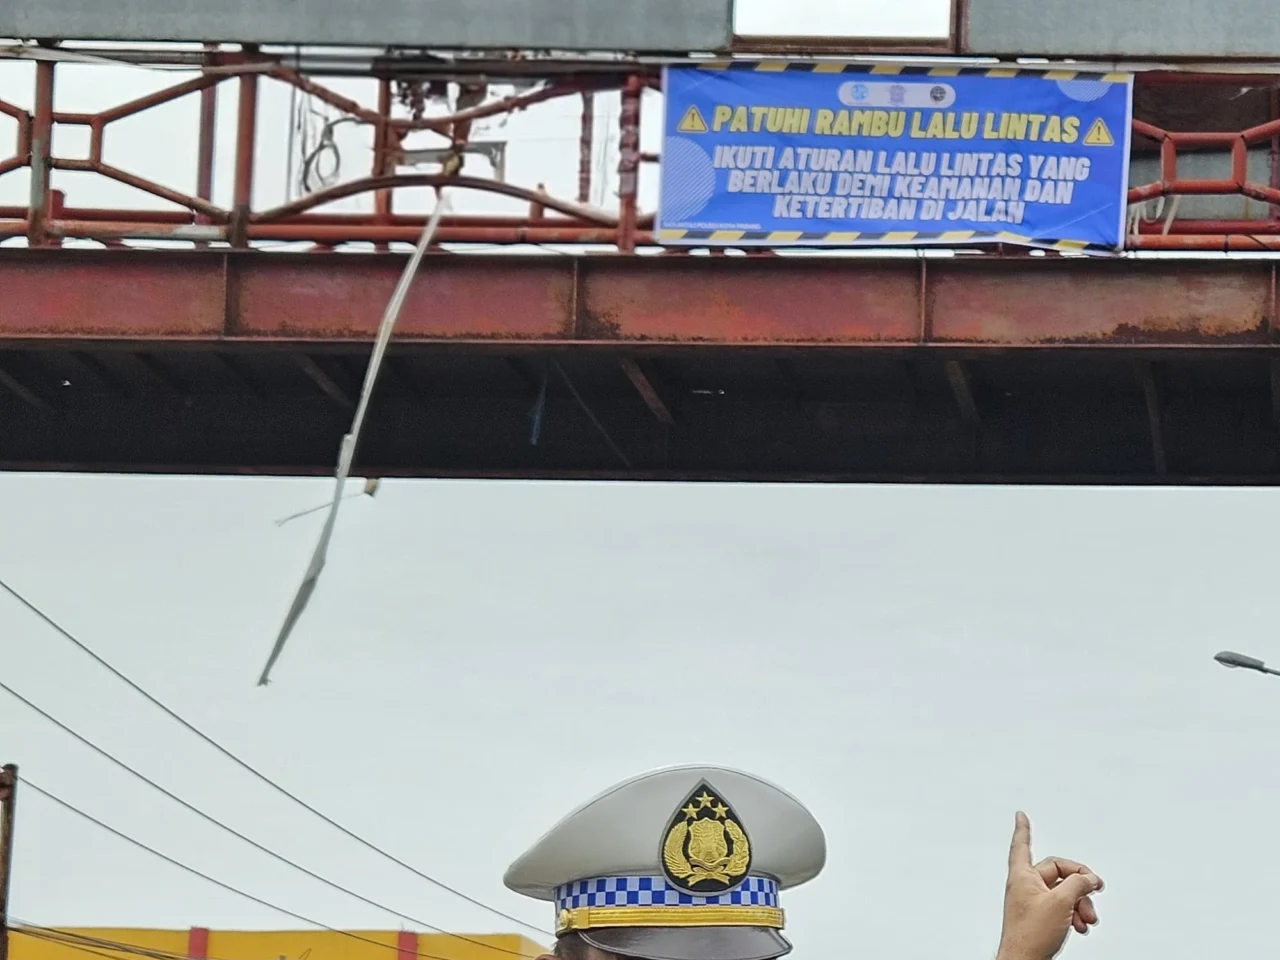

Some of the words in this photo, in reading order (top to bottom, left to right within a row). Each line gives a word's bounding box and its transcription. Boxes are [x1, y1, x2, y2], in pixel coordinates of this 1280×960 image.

[712, 105, 810, 134] PATUHI
[814, 109, 906, 138] RAMBU
[910, 111, 979, 139] LALU
[983, 112, 1081, 144] LINTAS
[713, 145, 775, 169] IKUTI
[778, 147, 873, 173] ATURAN
[877, 150, 937, 176] LALU
[940, 152, 1024, 177] LINTAS
[1028, 155, 1091, 181] YANG
[727, 170, 832, 195] BERLAKU
[835, 173, 891, 197] DEMI
[893, 175, 1012, 200] KEAMANAN
[1014, 180, 1074, 204] DAN
[773, 195, 917, 220] KETERTIBAN
[920, 200, 945, 220] DI
[947, 201, 1026, 224] JALAN
